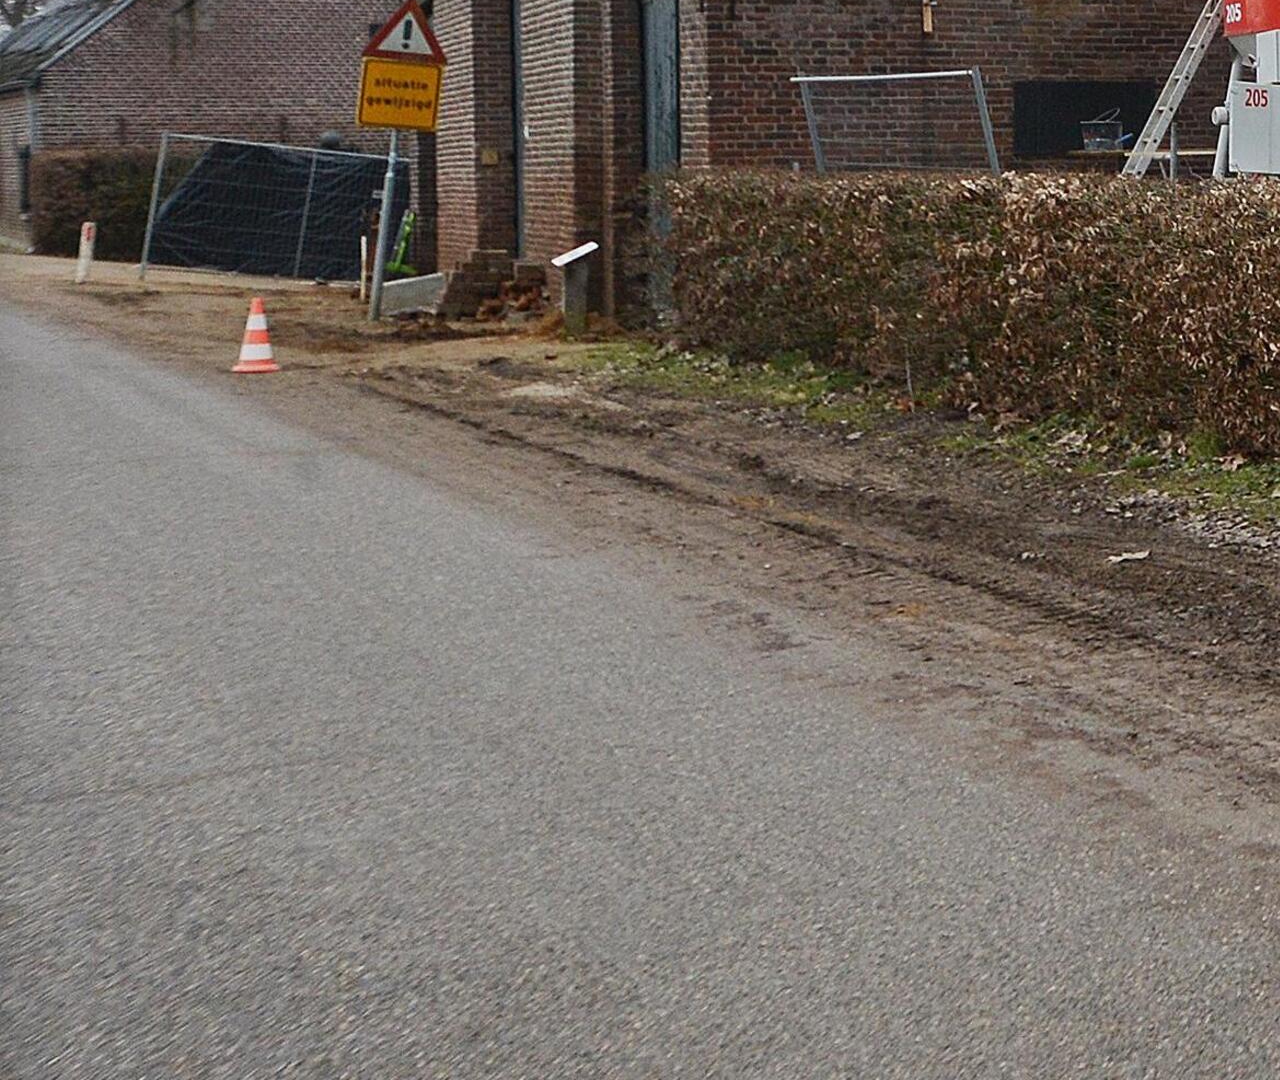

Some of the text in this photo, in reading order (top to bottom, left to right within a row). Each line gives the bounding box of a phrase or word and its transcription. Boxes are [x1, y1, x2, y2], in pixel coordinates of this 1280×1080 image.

[1225, 3, 1242, 23] 205
[374, 77, 428, 90] situatie
[366, 96, 432, 111] gewijzigd
[1244, 88, 1268, 108] 205
